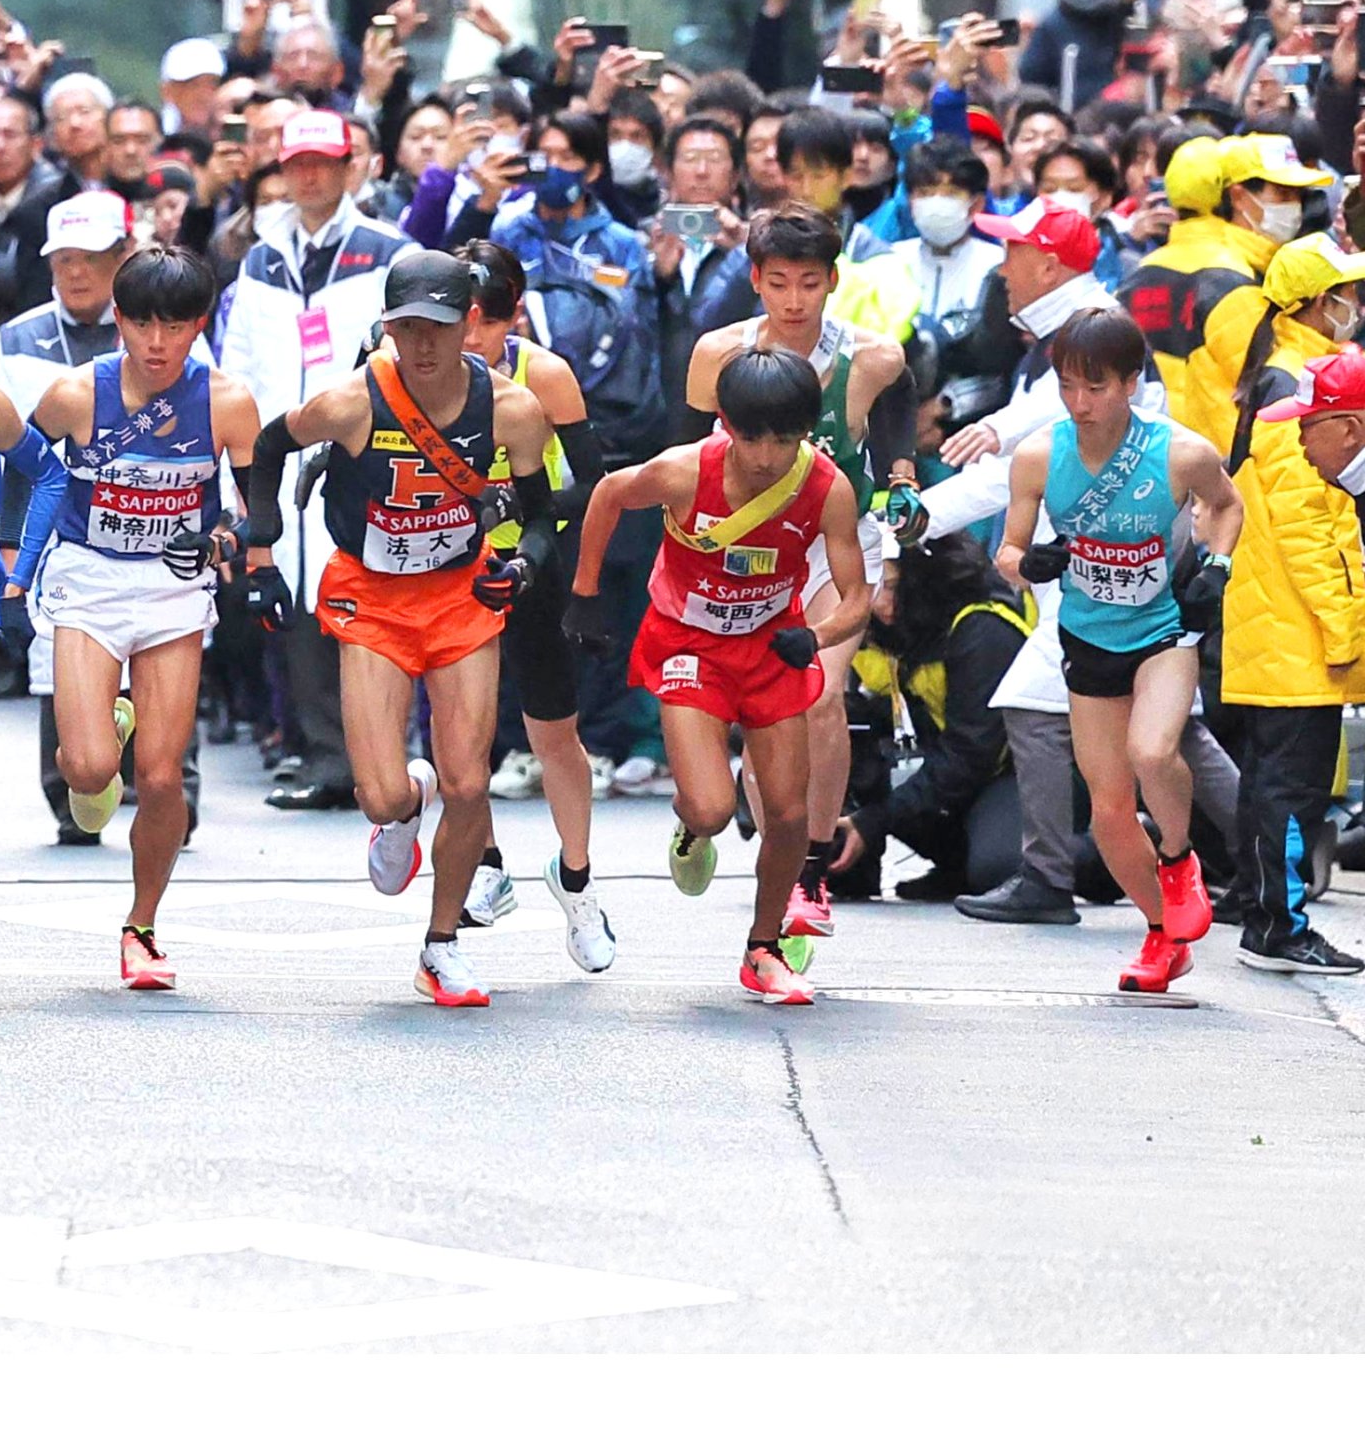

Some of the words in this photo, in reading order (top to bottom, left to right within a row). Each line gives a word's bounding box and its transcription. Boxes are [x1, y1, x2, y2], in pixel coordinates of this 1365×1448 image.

[118, 492, 198, 512] SAPPORO
[99, 510, 194, 538] 神奈川大
[389, 504, 470, 531] SAPPORO
[387, 531, 453, 556] 法大
[1084, 541, 1160, 564] SAPPORO
[396, 556, 441, 572] 7-16
[1073, 564, 1159, 588] 山梨学大
[1091, 584, 1137, 604] 23-1
[704, 598, 777, 621] 城西大
